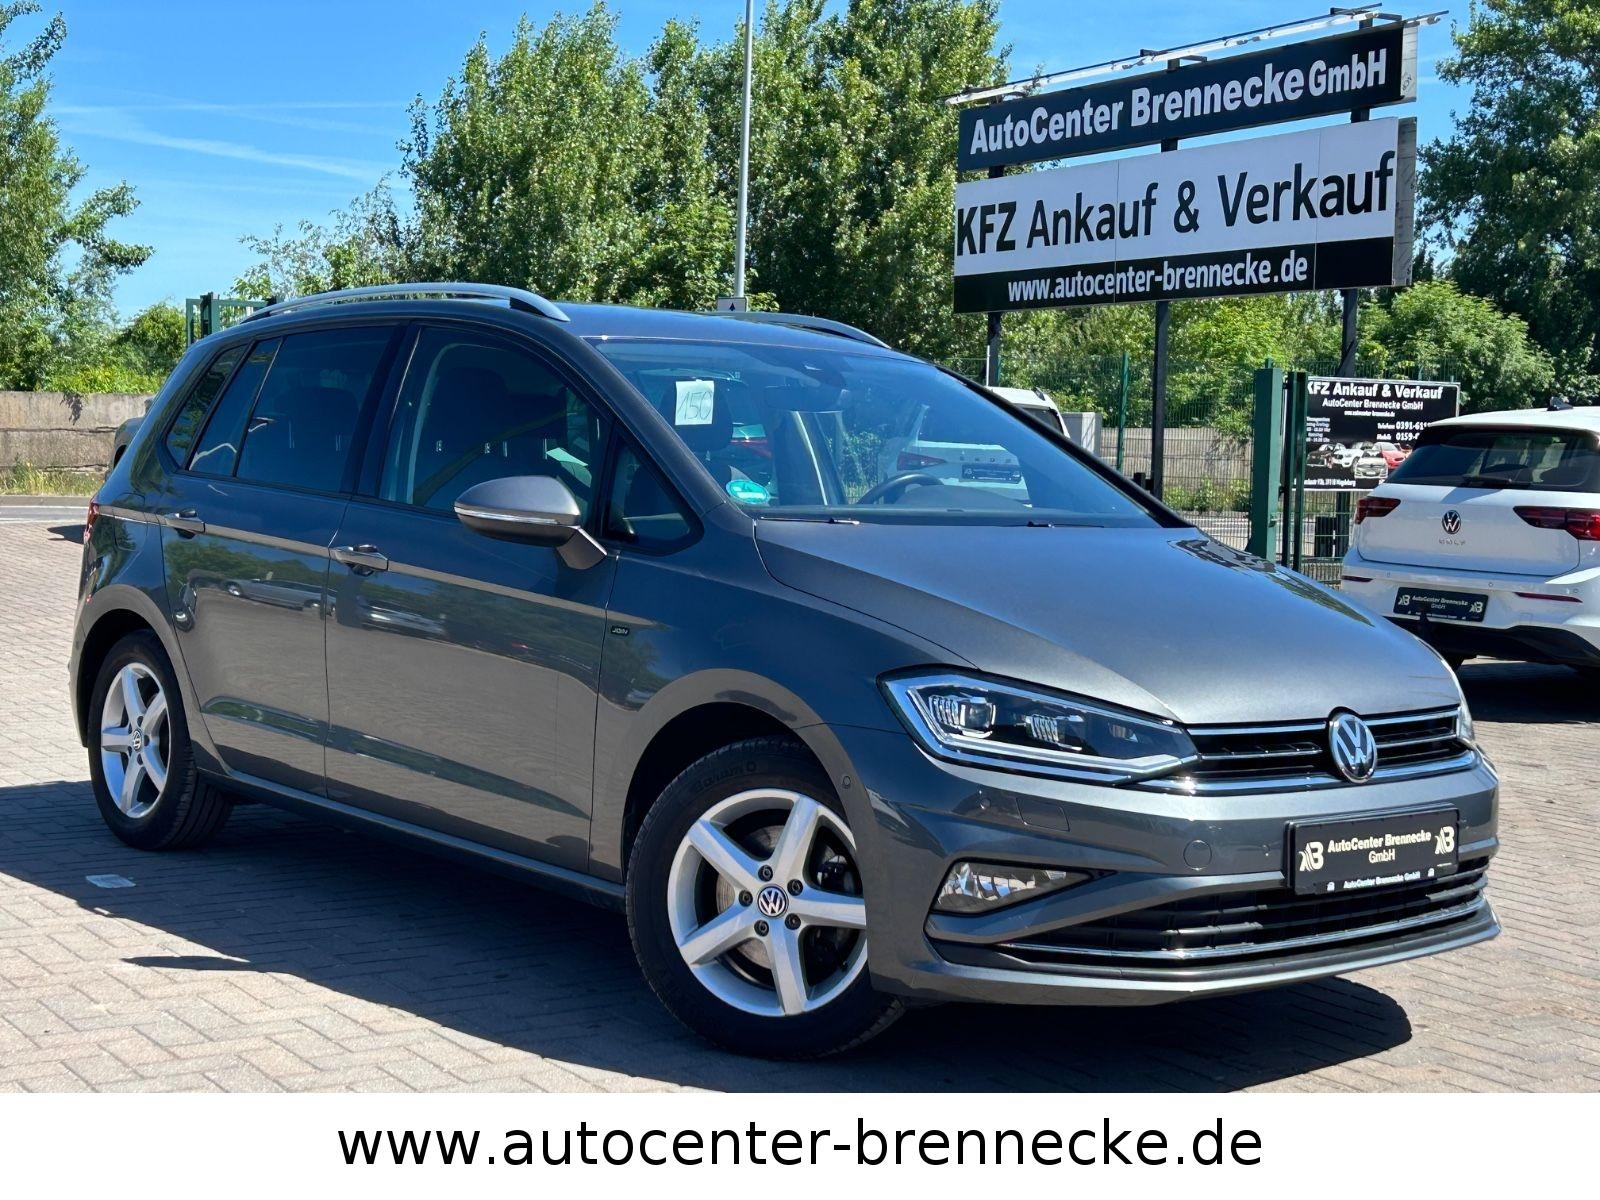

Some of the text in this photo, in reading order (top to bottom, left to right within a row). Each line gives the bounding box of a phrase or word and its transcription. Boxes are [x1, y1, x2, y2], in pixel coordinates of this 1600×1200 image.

[970, 48, 1387, 155] AutoCenter Brennecke GmbH
[957, 150, 1395, 256] KFZ Ankauf & Verkauf
[1008, 249, 1308, 302] www.autocenter-brennecke.de
[1333, 383, 1378, 397] Ankauf
[1381, 384, 1392, 398] &
[1395, 385, 1443, 399] Verkauf
[1322, 398, 1423, 411] AutoCenter Brennecke GmbH
[1328, 837, 1384, 853] AutoCenter
[1384, 829, 1432, 847] Brennecke
[1368, 848, 1396, 864] GmbH
